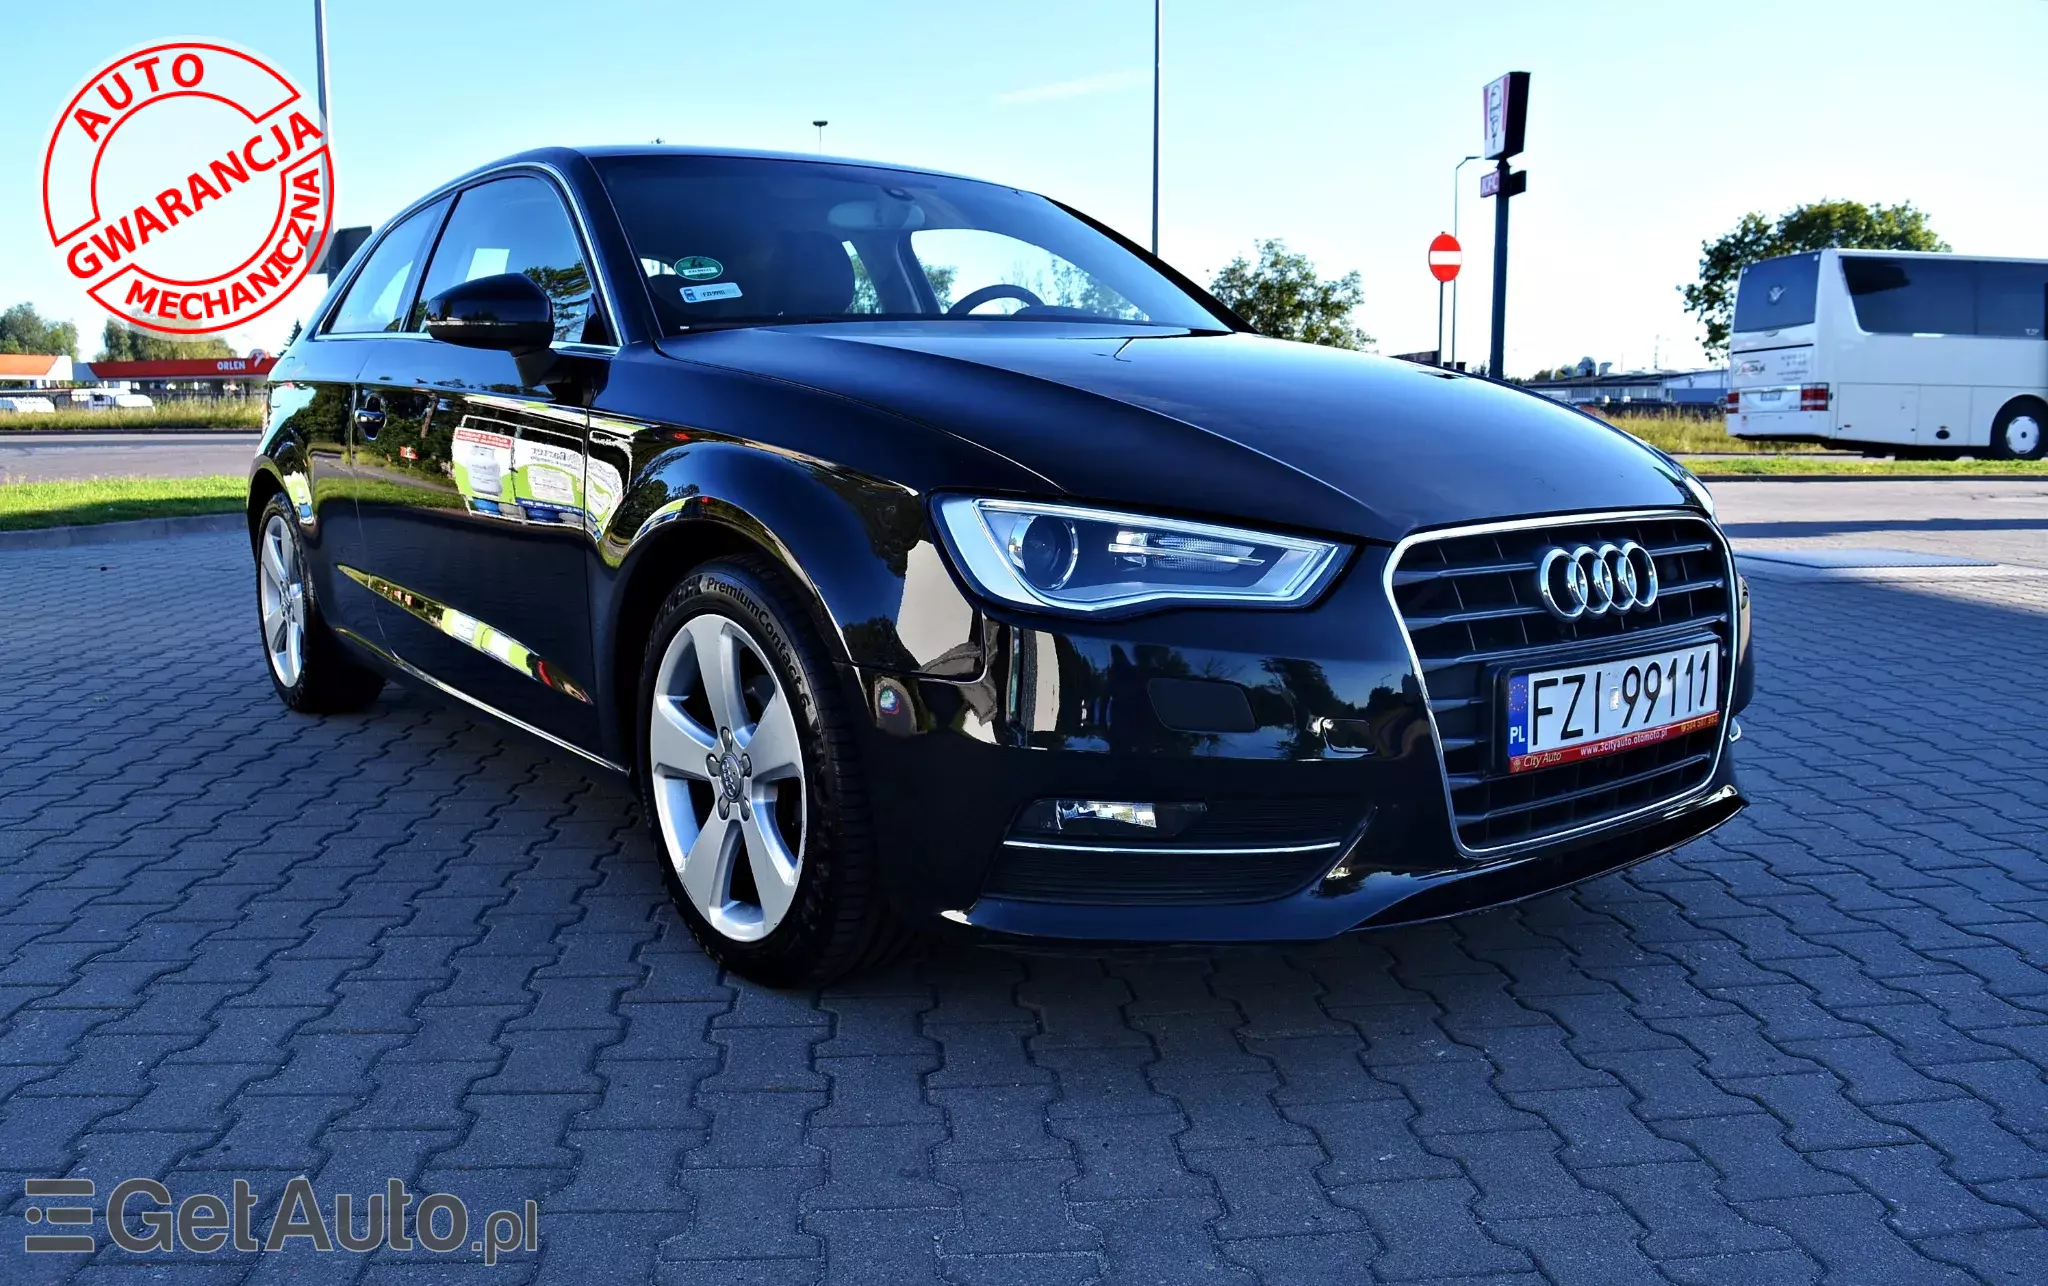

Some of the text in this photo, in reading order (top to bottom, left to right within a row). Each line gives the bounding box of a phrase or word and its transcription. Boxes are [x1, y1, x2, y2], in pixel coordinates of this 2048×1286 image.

[216, 360, 246, 371] ORLEN
[706, 577, 802, 692] PremiumContact
[1532, 650, 1711, 746] FZI 99111
[1509, 726, 1525, 744] PL
[1580, 728, 1668, 756] www.3cityauto.otomoto.pl
[1523, 750, 1562, 768] City Auto
